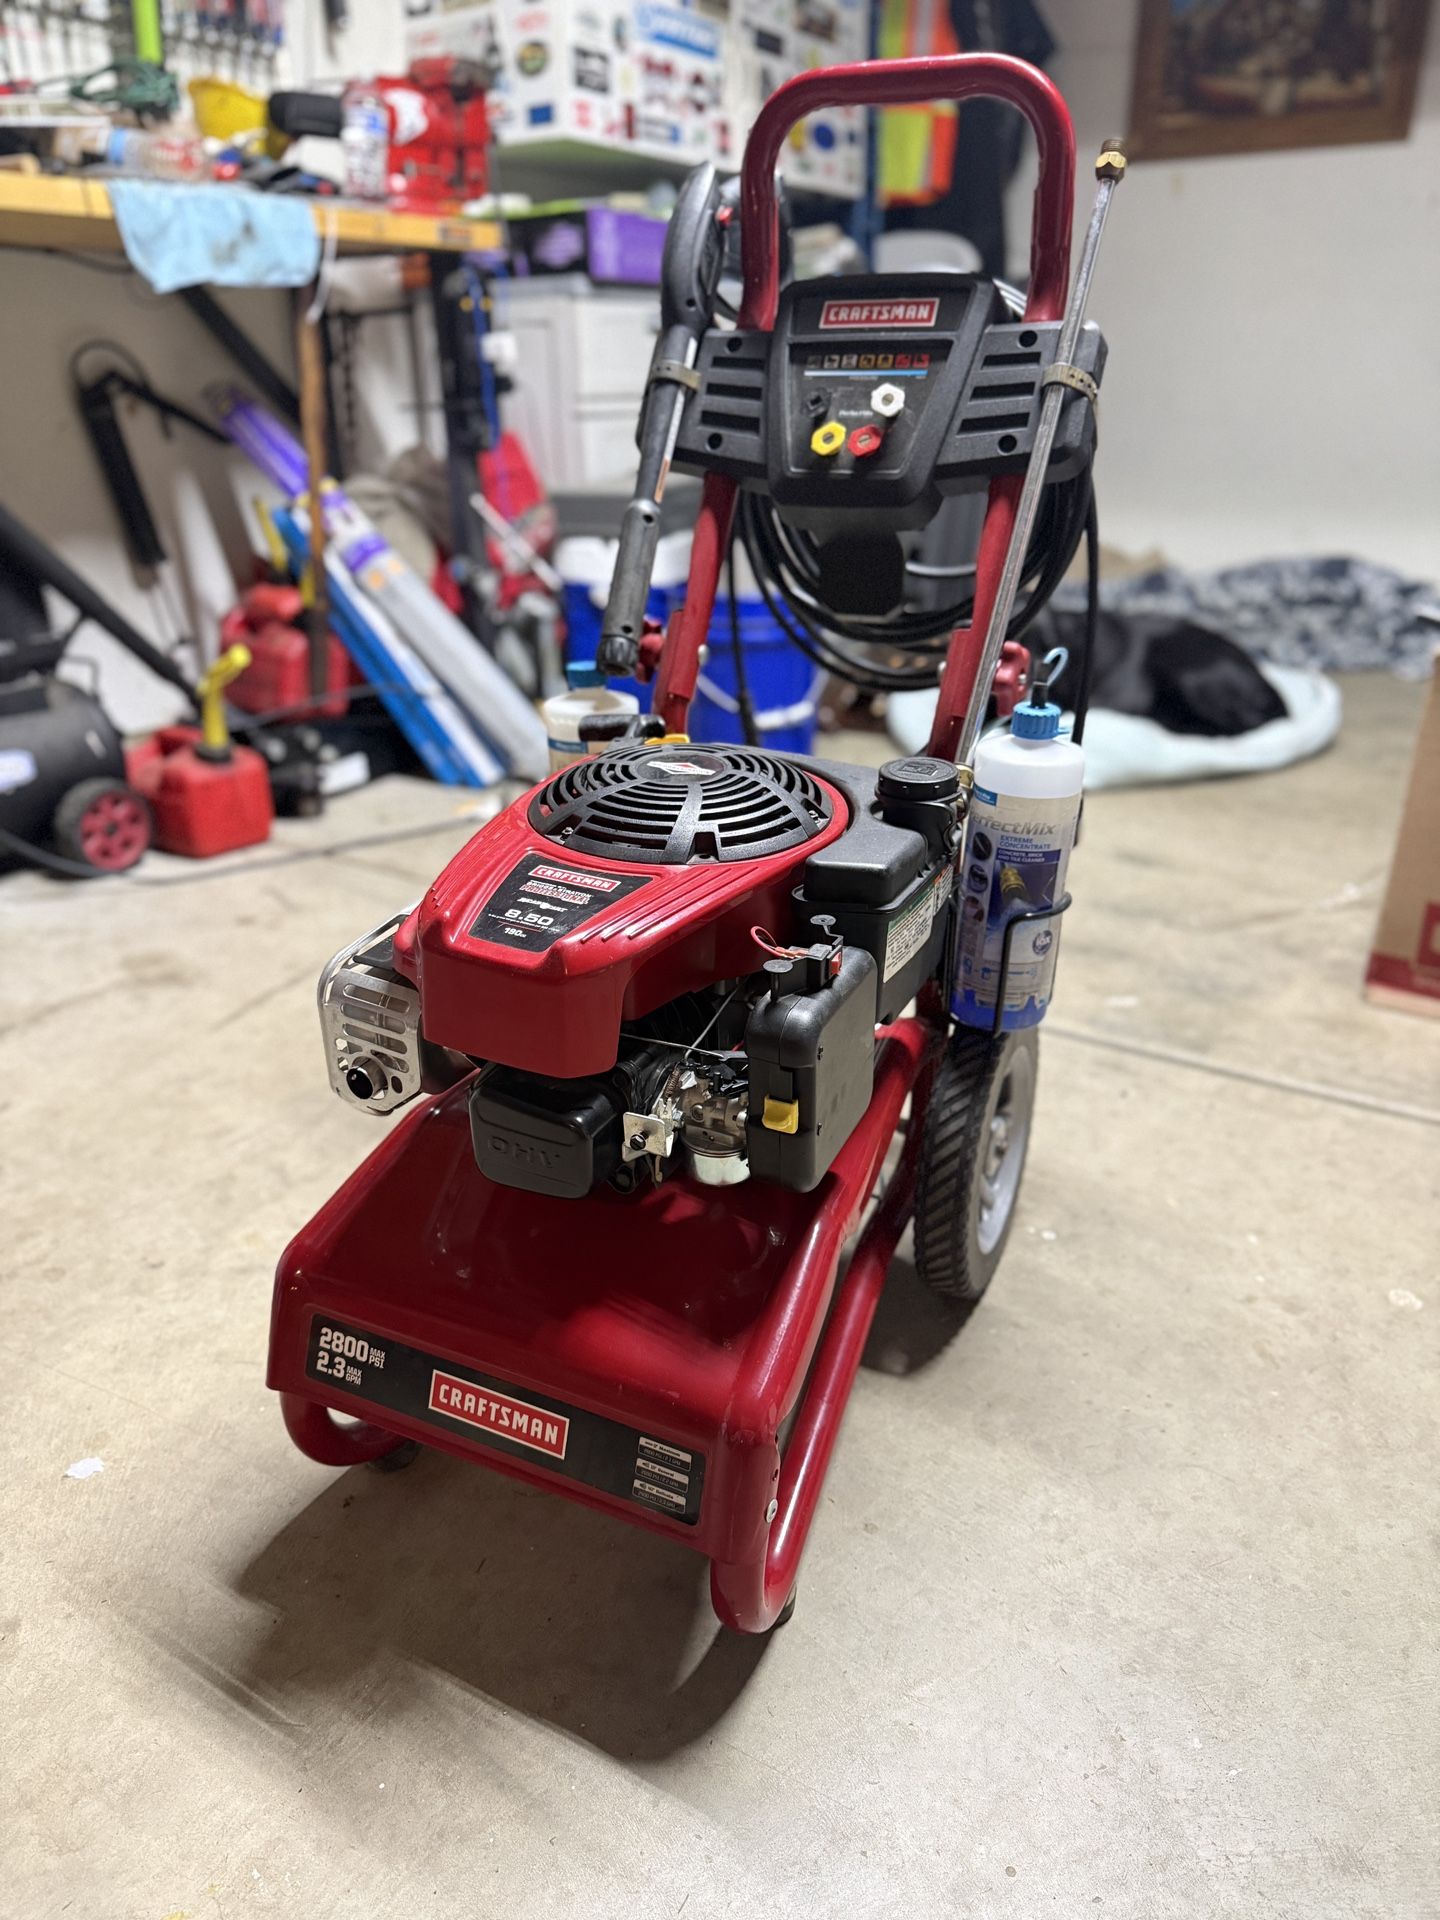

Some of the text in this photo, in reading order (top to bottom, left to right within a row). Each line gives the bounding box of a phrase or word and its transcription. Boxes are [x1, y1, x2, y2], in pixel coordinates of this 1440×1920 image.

[828, 304, 930, 322] CRAFTSMAN
[1000, 835, 1033, 844] EXTREME
[1000, 841, 1051, 850] CONCENTRATE
[536, 868, 612, 889] CRAFTSMAN
[504, 908, 554, 926] 8.50
[319, 1327, 369, 1362] 2800
[369, 1347, 386, 1359] MAX
[316, 1350, 346, 1378] 2.3
[368, 1355, 385, 1369] PSI
[345, 1373, 361, 1385] GPM
[346, 1365, 362, 1377] MAX
[439, 1384, 559, 1445] CRAFTSMAN
